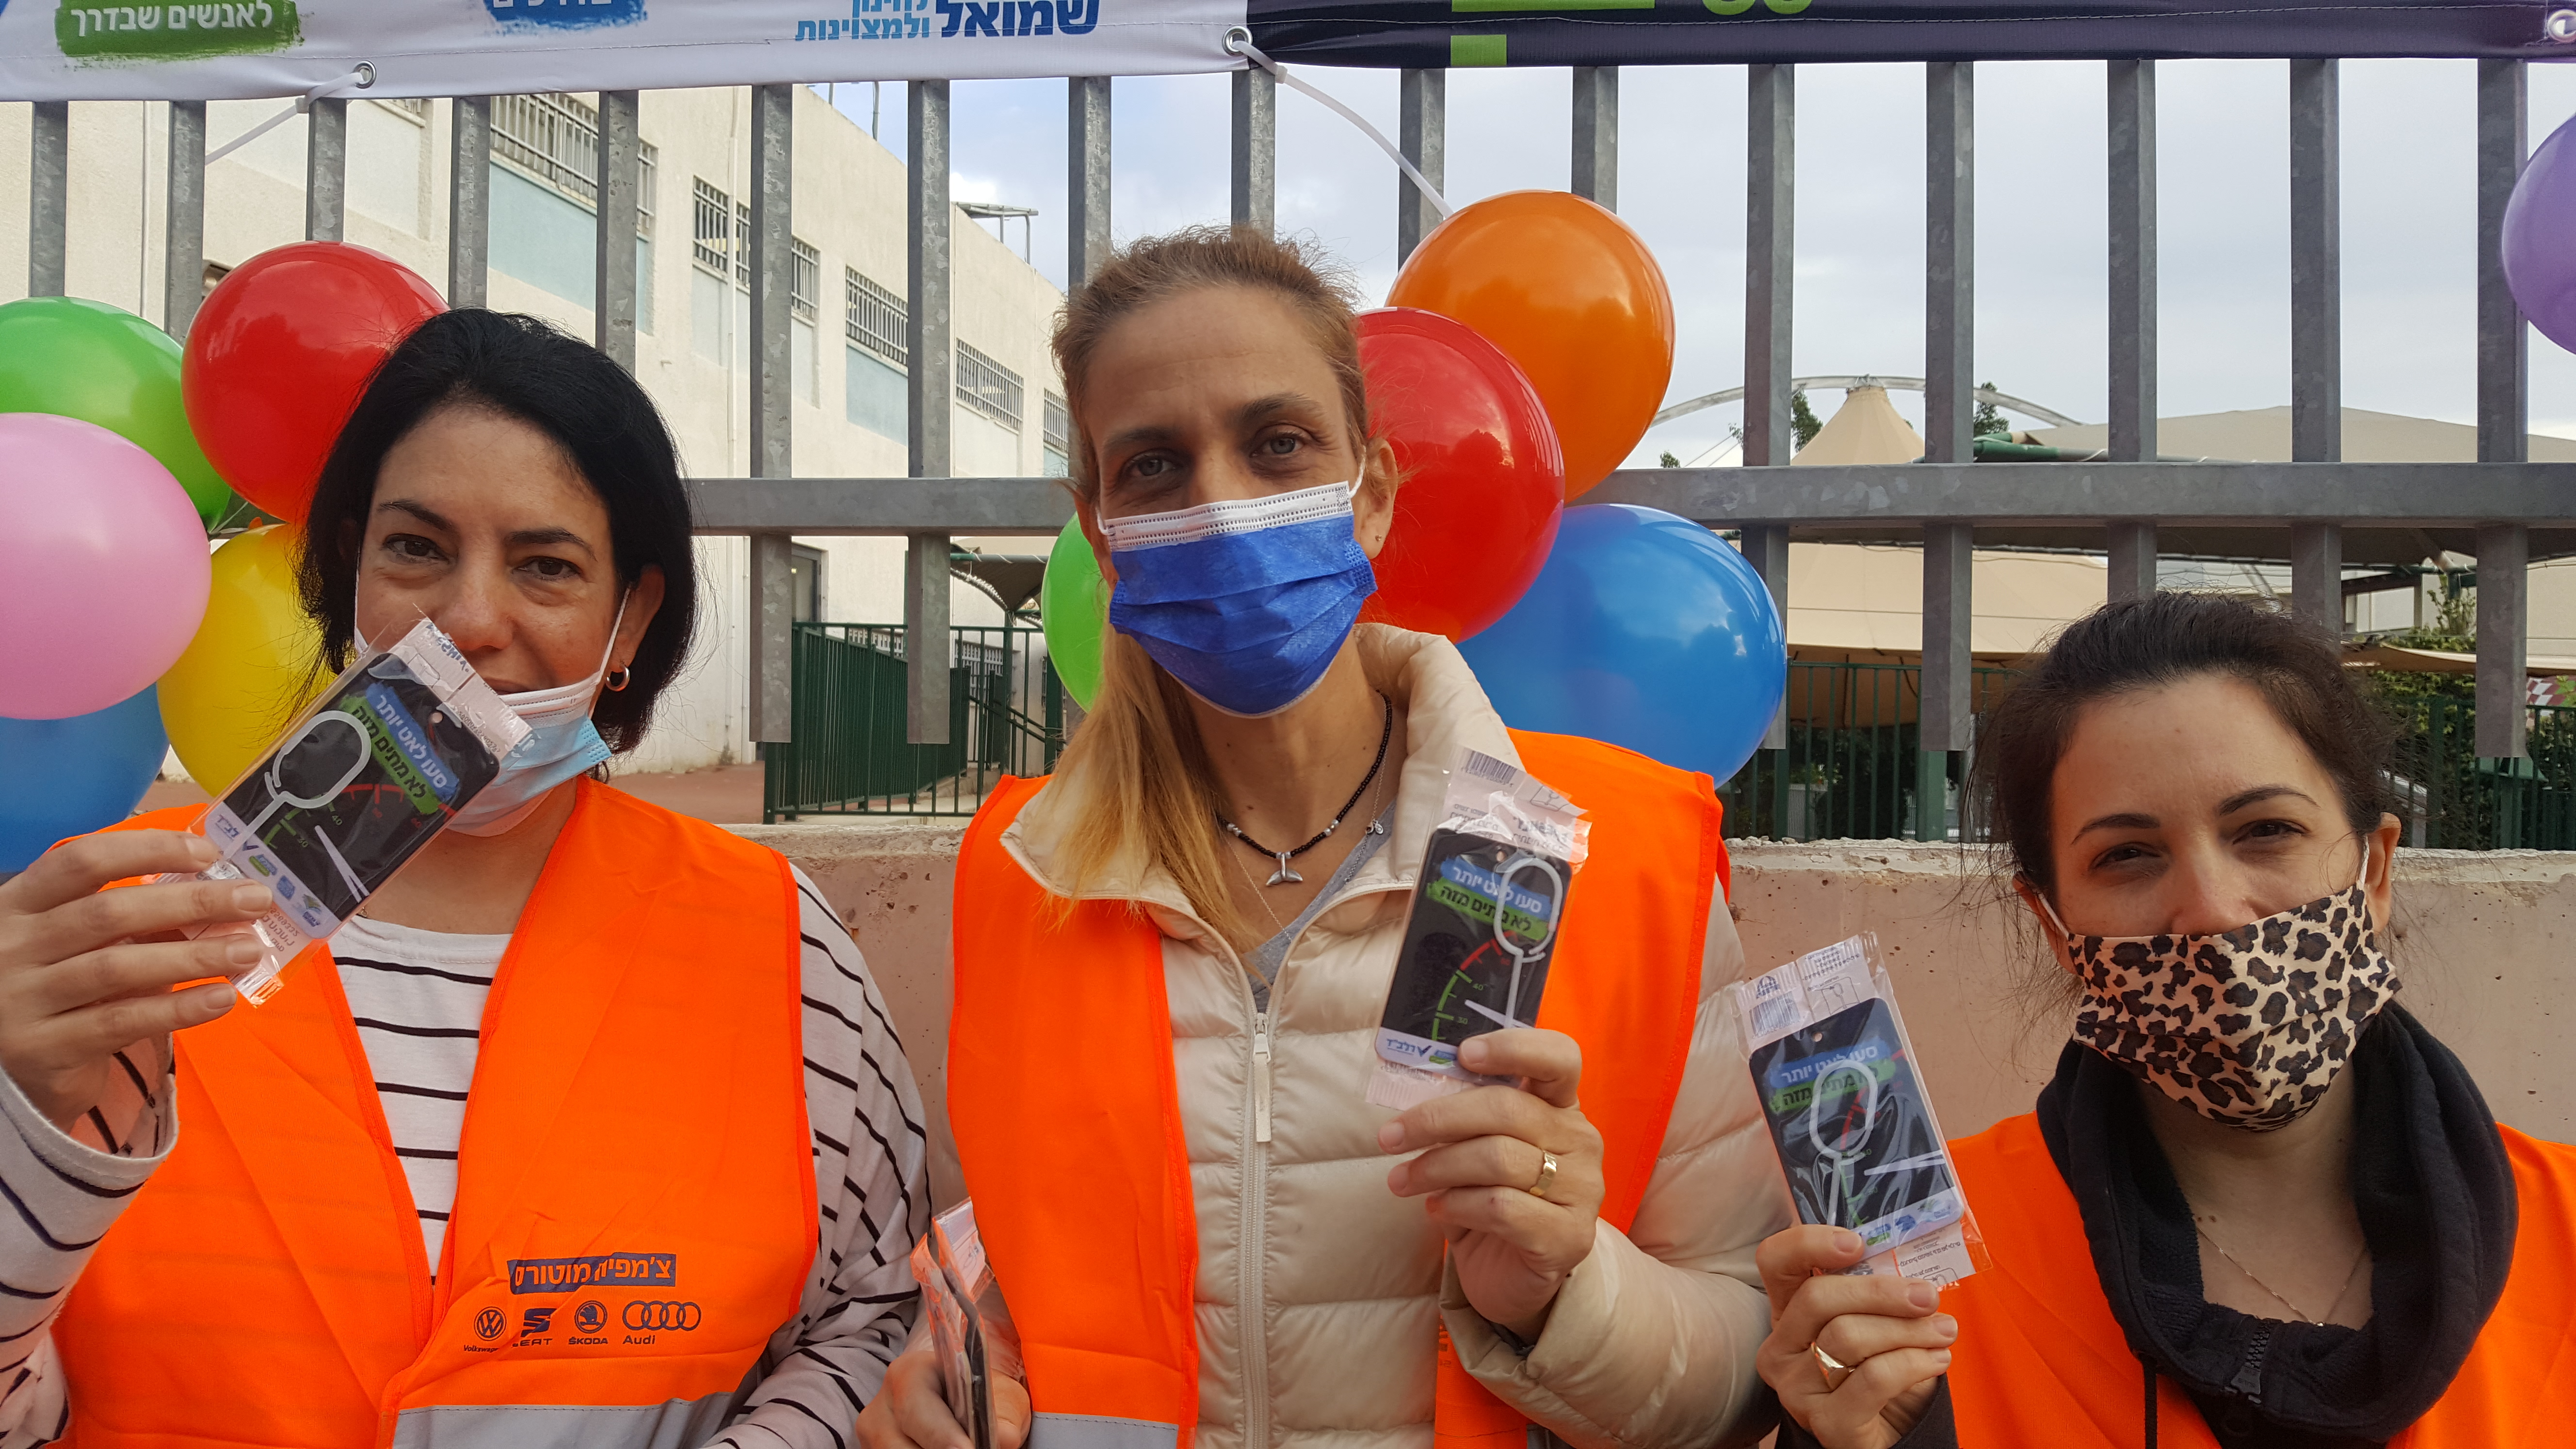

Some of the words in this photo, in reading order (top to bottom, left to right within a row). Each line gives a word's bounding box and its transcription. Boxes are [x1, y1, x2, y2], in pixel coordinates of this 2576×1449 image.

[71, 5, 161, 37] שבדרך
[168, 0, 273, 30] לאנשים
[795, 12, 930, 41] ולמצוינות
[935, 0, 1100, 38] שמואל
[376, 694, 404, 726] יותר
[398, 726, 427, 759] לאט
[374, 736, 410, 779] מתים
[403, 775, 426, 798] לא
[332, 815, 342, 825] 40
[1453, 867, 1483, 887] יותר
[1440, 886, 1470, 907] מזה
[1511, 915, 1531, 931] לא
[1781, 1065, 1813, 1083] יותר
[623, 1335, 656, 1345] Audi
